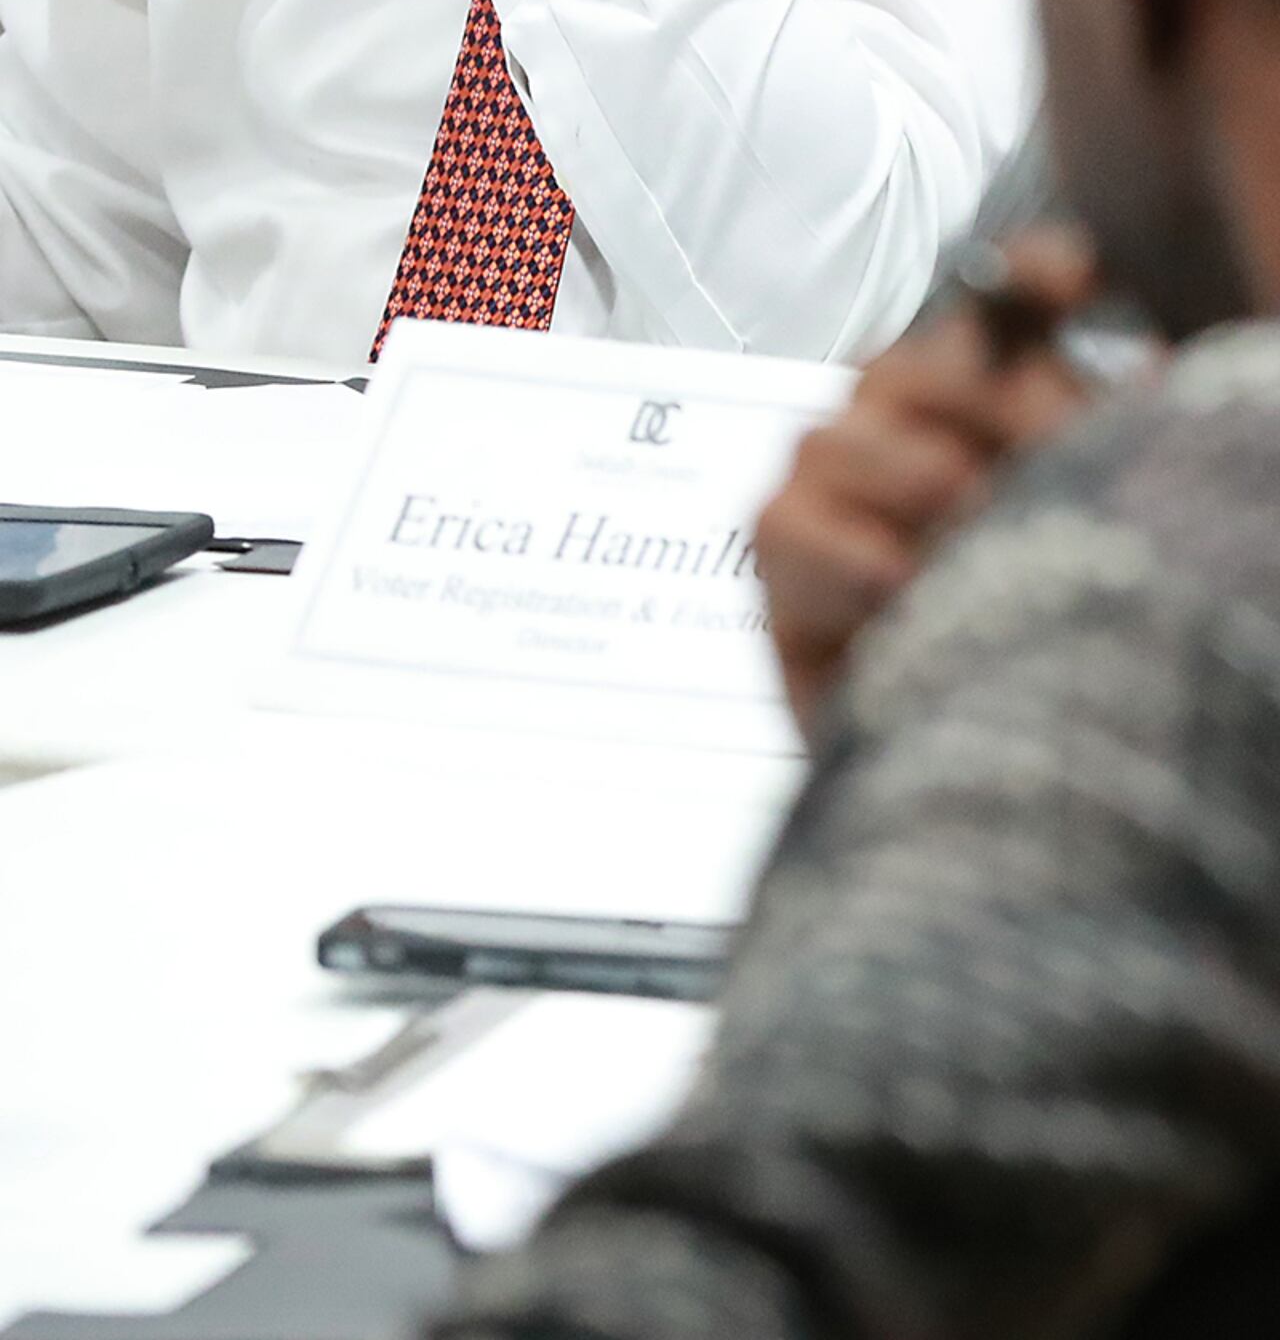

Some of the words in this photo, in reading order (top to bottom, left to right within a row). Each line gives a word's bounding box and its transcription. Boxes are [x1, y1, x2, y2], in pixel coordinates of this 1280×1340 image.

[387, 493, 534, 559] Erica
[554, 511, 764, 580] Hamilt
[350, 565, 431, 603] Voter
[440, 572, 623, 623] Registration
